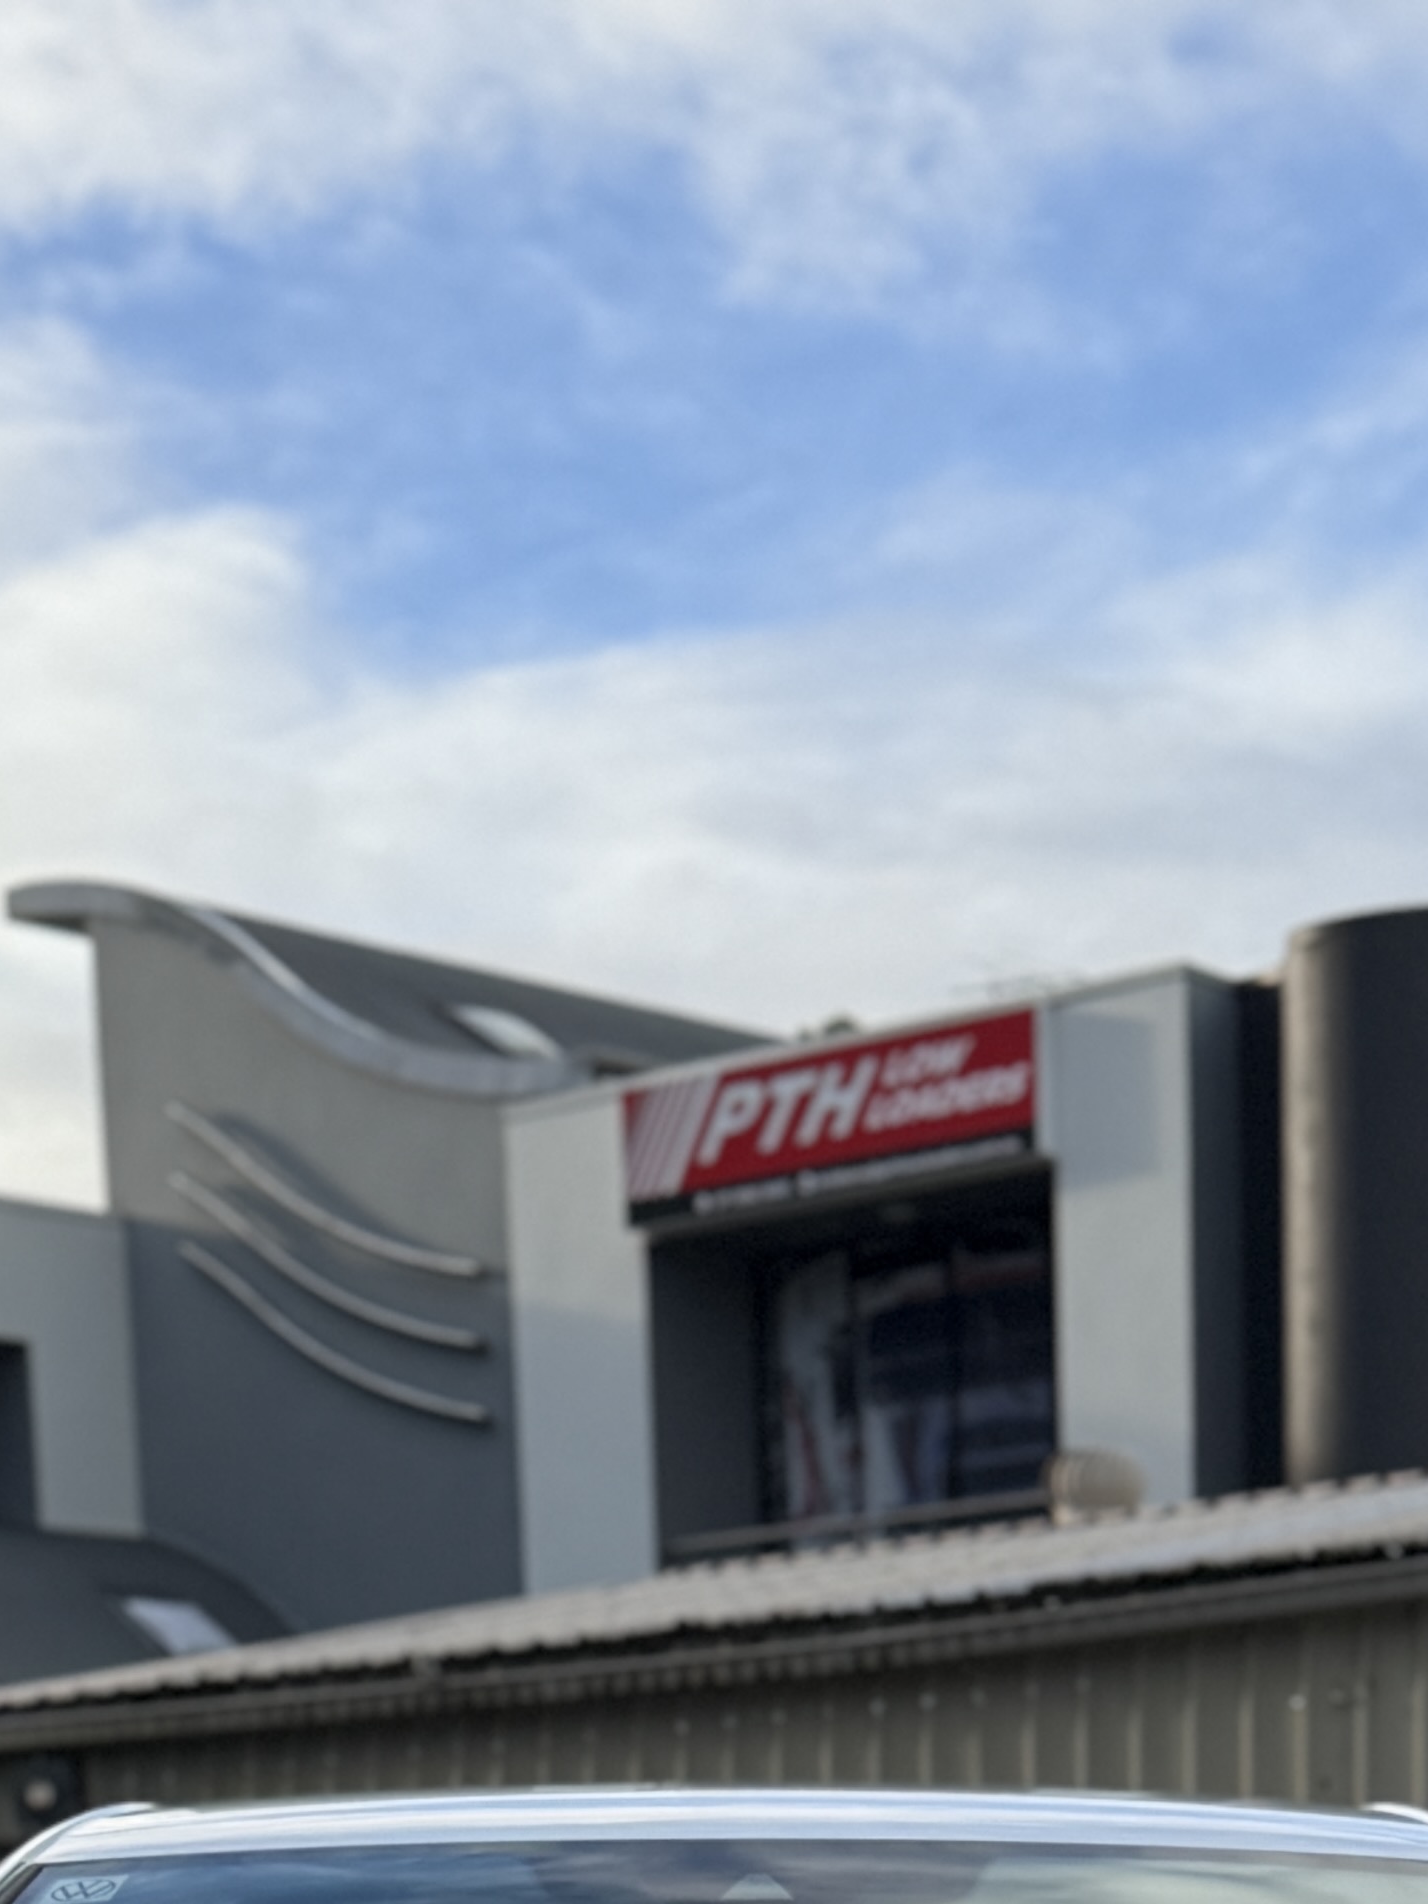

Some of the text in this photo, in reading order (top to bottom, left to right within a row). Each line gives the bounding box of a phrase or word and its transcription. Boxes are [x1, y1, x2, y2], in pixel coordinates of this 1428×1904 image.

[862, 1060, 1033, 1133] LOADERS
[882, 1034, 977, 1088] LOW
[695, 1053, 878, 1168] PTH
